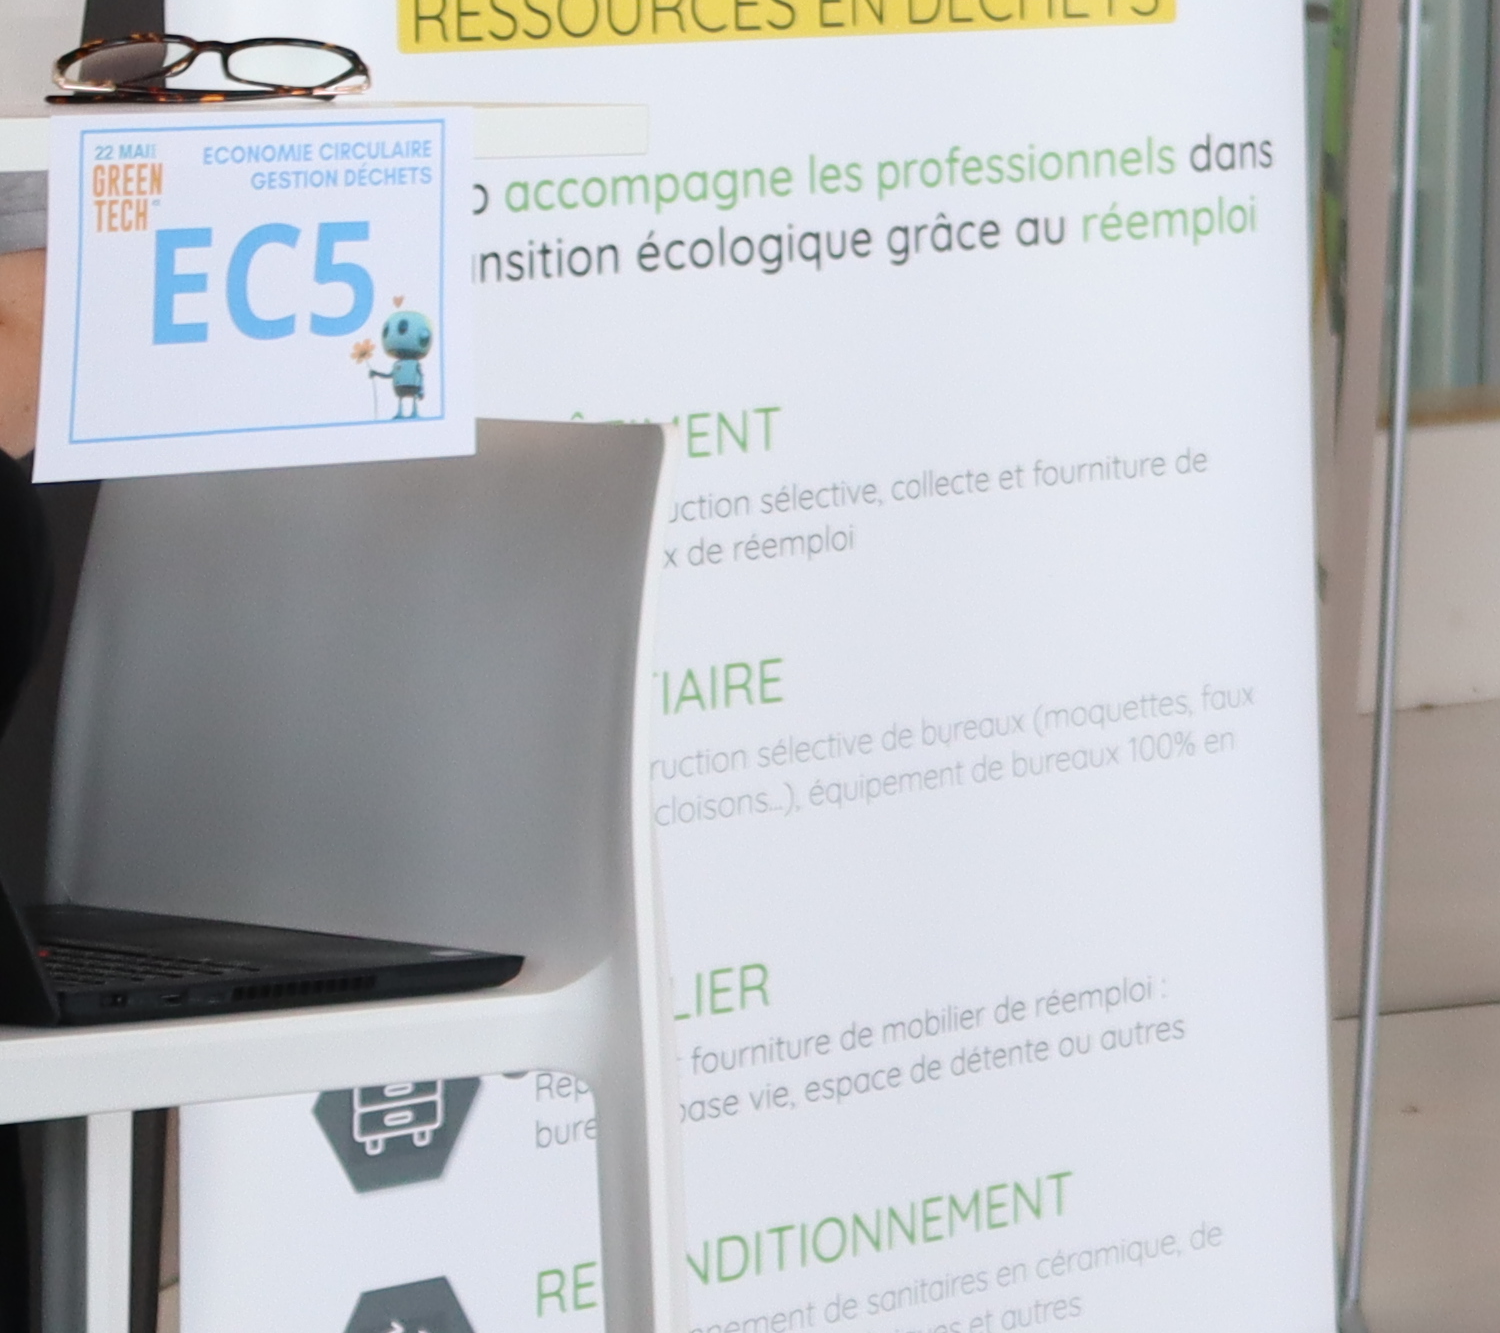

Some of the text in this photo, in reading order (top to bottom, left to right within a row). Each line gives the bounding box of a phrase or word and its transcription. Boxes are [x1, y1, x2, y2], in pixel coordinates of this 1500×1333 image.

[92, 162, 164, 198] GREEN
[94, 144, 114, 161] 22
[202, 139, 432, 166] ECONOMIE CIRCULAIRE
[250, 162, 432, 191] GESTION DÉCHETS
[504, 165, 794, 215] accompagne
[808, 153, 863, 195] les
[877, 135, 1176, 200] professionnels
[1189, 132, 1273, 173] dans
[94, 198, 149, 233] TECH
[471, 195, 1258, 284] nsition écologique grâce au réemploi
[152, 220, 375, 345] EC5
[760, 481, 884, 515] sélective,
[890, 467, 989, 502] collecte
[998, 464, 1025, 491] et
[1032, 451, 1166, 488] fourniture
[1174, 446, 1209, 476] de
[687, 536, 723, 568] de
[733, 524, 855, 562] réemploi
[652, 657, 784, 716] IAIRE
[757, 731, 873, 768] sélective
[882, 721, 913, 752] de
[921, 709, 1026, 747] bureaux
[1033, 690, 1193, 733] (moquettes,
[1200, 681, 1255, 713] faux
[808, 758, 964, 810] équipement
[970, 756, 1005, 787] de
[1011, 742, 1119, 780] bureaux
[1127, 731, 1196, 764] 100%
[1203, 728, 1236, 755] en
[690, 1029, 832, 1077] fourniture
[840, 1019, 874, 1051] de
[882, 1006, 985, 1046] mobilier
[993, 996, 1027, 1026] de
[1034, 976, 1153, 1020] réemploi
[749, 1083, 797, 1113] vie,
[804, 1065, 902, 1106] espace
[910, 1053, 942, 1083] de
[950, 1036, 1050, 1078] détente
[1058, 1031, 1092, 1058] ou
[1101, 1016, 1186, 1053] autres
[823, 1292, 859, 1324] de
[866, 1270, 989, 1316] sanitaires
[996, 1262, 1028, 1288] en
[1034, 1231, 1183, 1280] céramique,
[1189, 1220, 1225, 1251] de
[1000, 1295, 1083, 1332] autres
